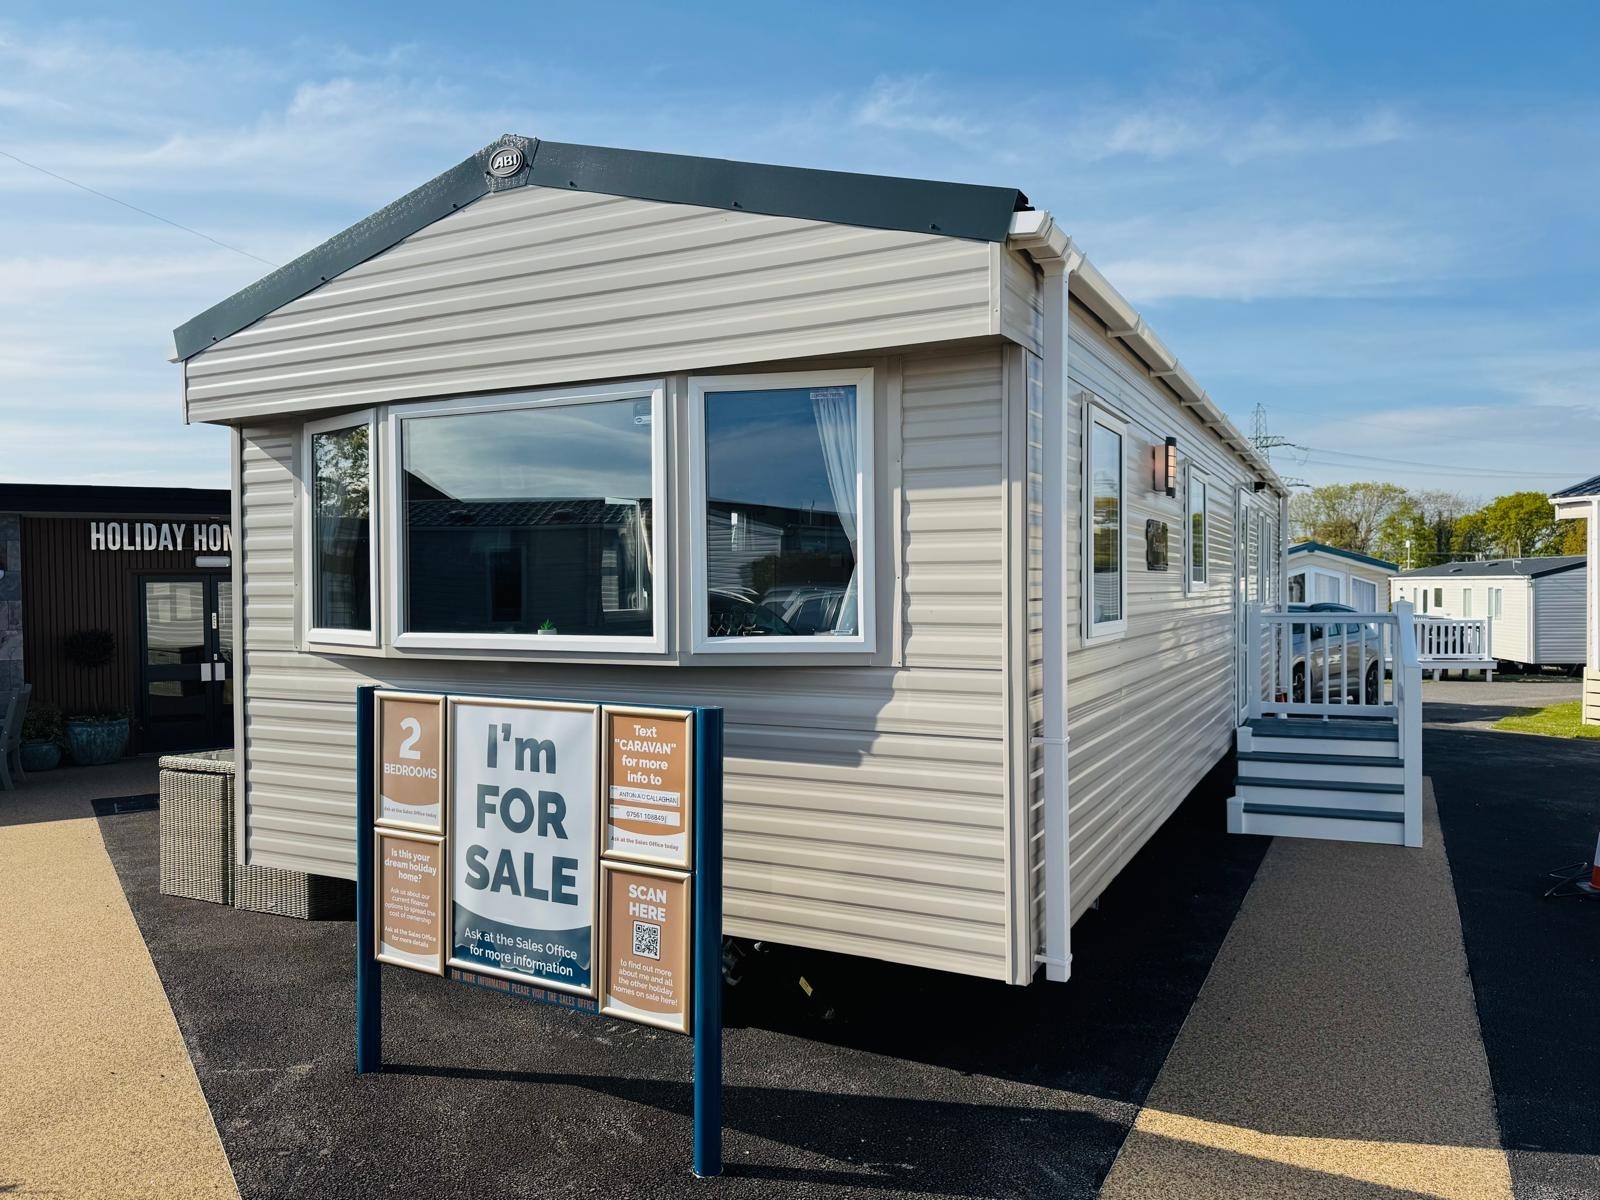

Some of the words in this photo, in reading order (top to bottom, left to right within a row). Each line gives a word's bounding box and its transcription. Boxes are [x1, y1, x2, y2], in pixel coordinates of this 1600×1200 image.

[494, 154, 518, 169] ABI
[90, 522, 186, 550] HOLIDAY
[399, 717, 421, 760] 2
[633, 724, 657, 738] Text
[487, 723, 557, 774] I'm
[384, 762, 437, 779] BEDROOMS
[621, 754, 638, 767] for
[639, 758, 669, 770] more
[627, 770, 648, 784] info
[649, 773, 662, 786] to
[476, 783, 569, 840] FOR
[391, 848, 398, 857] Is
[399, 849, 412, 859] this
[413, 853, 430, 862] your
[649, 840, 664, 848] Office
[664, 843, 679, 851] today
[384, 858, 408, 869] dream
[409, 861, 437, 876] holiday
[398, 870, 422, 883] home?
[464, 844, 579, 906] SALE
[628, 884, 667, 904] SCAN
[629, 901, 666, 922] HERE
[464, 927, 482, 940] Ask
[484, 931, 495, 943] at
[496, 932, 514, 946] the
[516, 936, 544, 953] Sales
[545, 943, 578, 960] Office
[469, 943, 484, 956] for
[485, 949, 512, 963] more
[513, 952, 573, 976] information
[620, 959, 628, 967] to
[628, 960, 641, 970] find
[642, 963, 654, 973] out
[654, 967, 672, 977] more
[618, 976, 629, 986] the
[630, 979, 648, 989] other
[648, 982, 673, 997] holiday
[619, 968, 638, 978] about
[639, 972, 650, 980] me
[650, 974, 664, 984] and
[664, 977, 673, 987] all
[613, 984, 635, 996] homes
[635, 990, 645, 998] on
[645, 990, 660, 1002] sale
[660, 995, 678, 1006] here!
